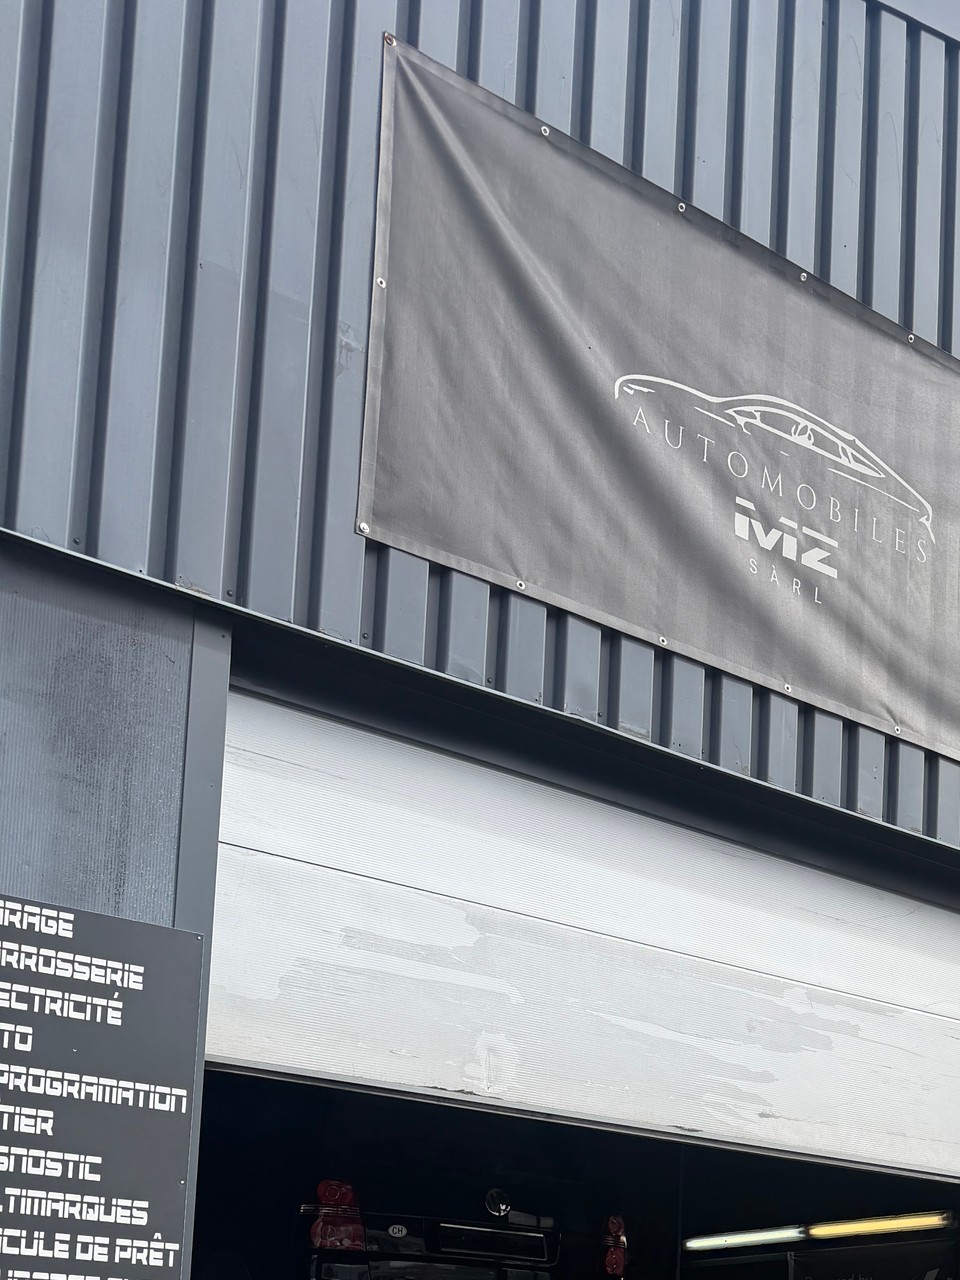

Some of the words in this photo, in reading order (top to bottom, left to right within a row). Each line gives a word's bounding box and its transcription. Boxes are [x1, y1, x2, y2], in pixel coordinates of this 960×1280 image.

[632, 406, 928, 563] AUTOMOBILES
[734, 496, 839, 580] MZ
[749, 558, 822, 604] SÀRL
[0, 900, 74, 939] RAGE
[0, 940, 144, 991] RROSSERIE
[0, 981, 124, 1026] ECTRICITÉ
[0, 1022, 33, 1052] TO
[0, 1104, 54, 1136] TIER
[0, 1187, 149, 1226] TIMARQUES
[75, 1234, 110, 1263] DE
[114, 1232, 180, 1268] PRÊT
